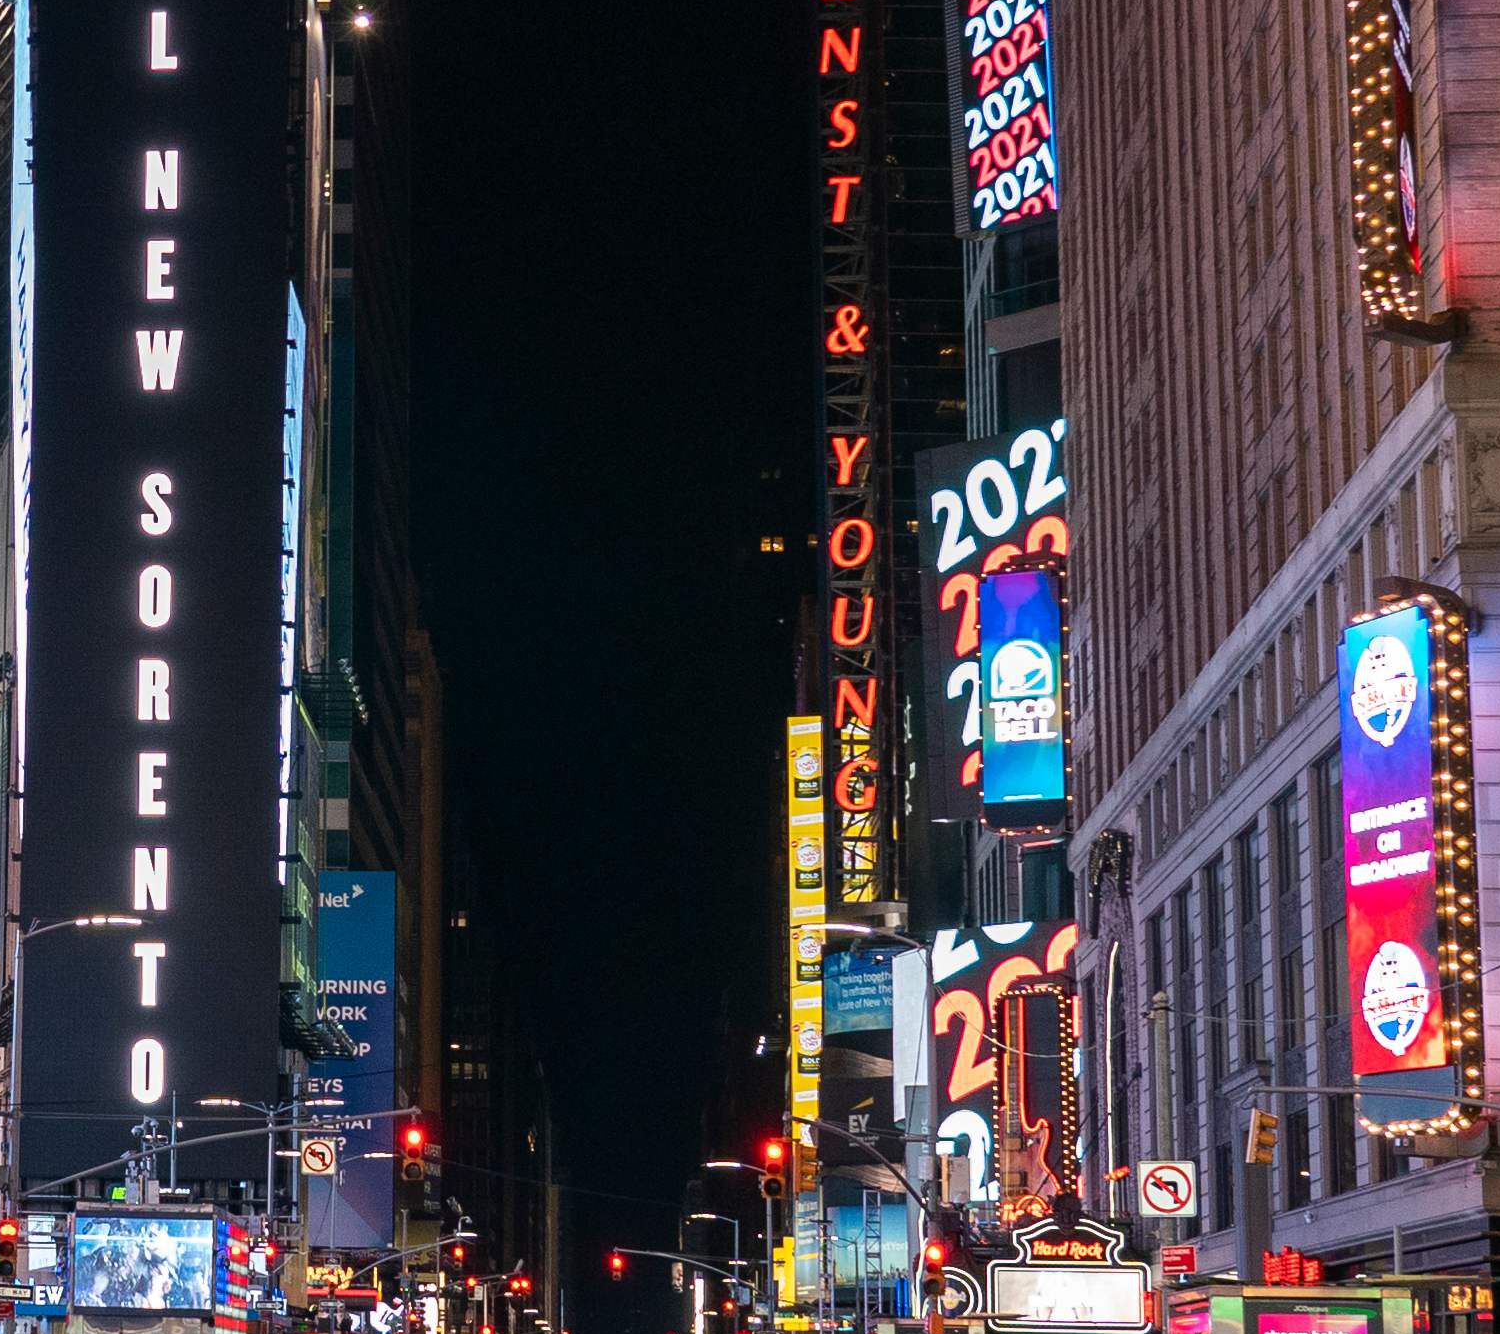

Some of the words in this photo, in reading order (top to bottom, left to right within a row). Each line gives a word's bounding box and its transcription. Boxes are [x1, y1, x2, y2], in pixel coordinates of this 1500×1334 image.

[971, 8, 1049, 96] 2021
[970, 101, 1053, 188] 2021
[136, 149, 184, 391] NEW
[825, 304, 869, 356] &
[827, 434, 878, 812] YOUNG
[989, 697, 1056, 721] TACO
[995, 718, 1058, 743] BELL
[131, 472, 172, 1104] SORENTO
[849, 1114, 869, 1133] EY
[1032, 1240, 1067, 1259] Hard
[1068, 1242, 1104, 1262] Rock
